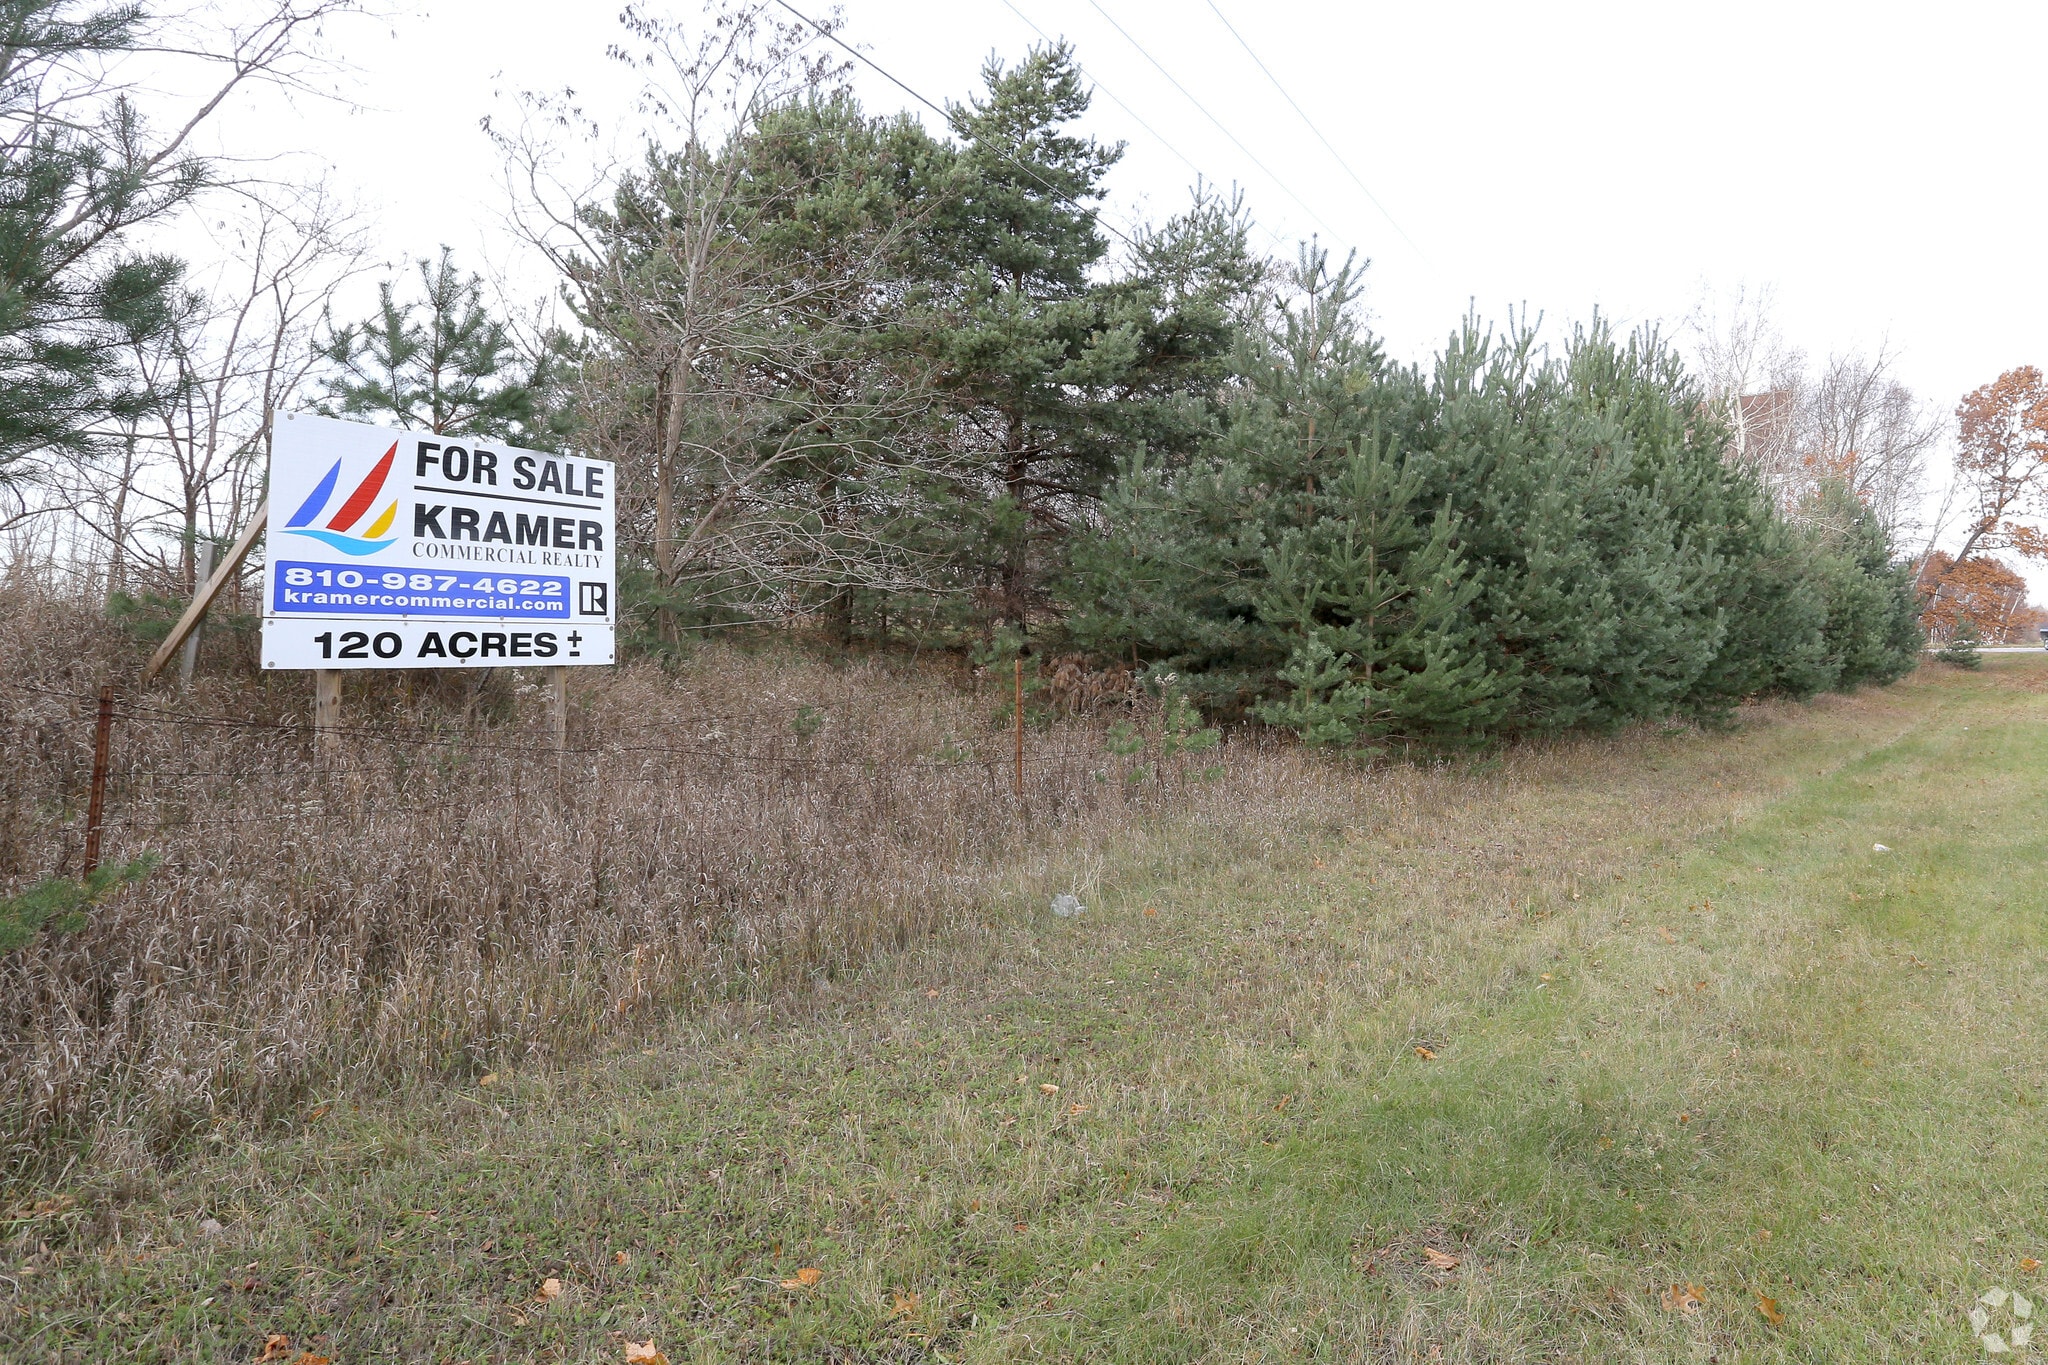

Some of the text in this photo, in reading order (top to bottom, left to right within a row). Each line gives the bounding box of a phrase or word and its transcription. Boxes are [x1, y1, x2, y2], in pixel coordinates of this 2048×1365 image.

[416, 441, 604, 499] FOR SALE
[413, 503, 604, 552] KRAMER
[412, 541, 603, 569] COMMERCIAL REALTY
[284, 567, 563, 596] 810-987-4622
[284, 589, 563, 610] kramercommercial.com
[314, 631, 403, 659] 120
[416, 632, 559, 658] ACRES
